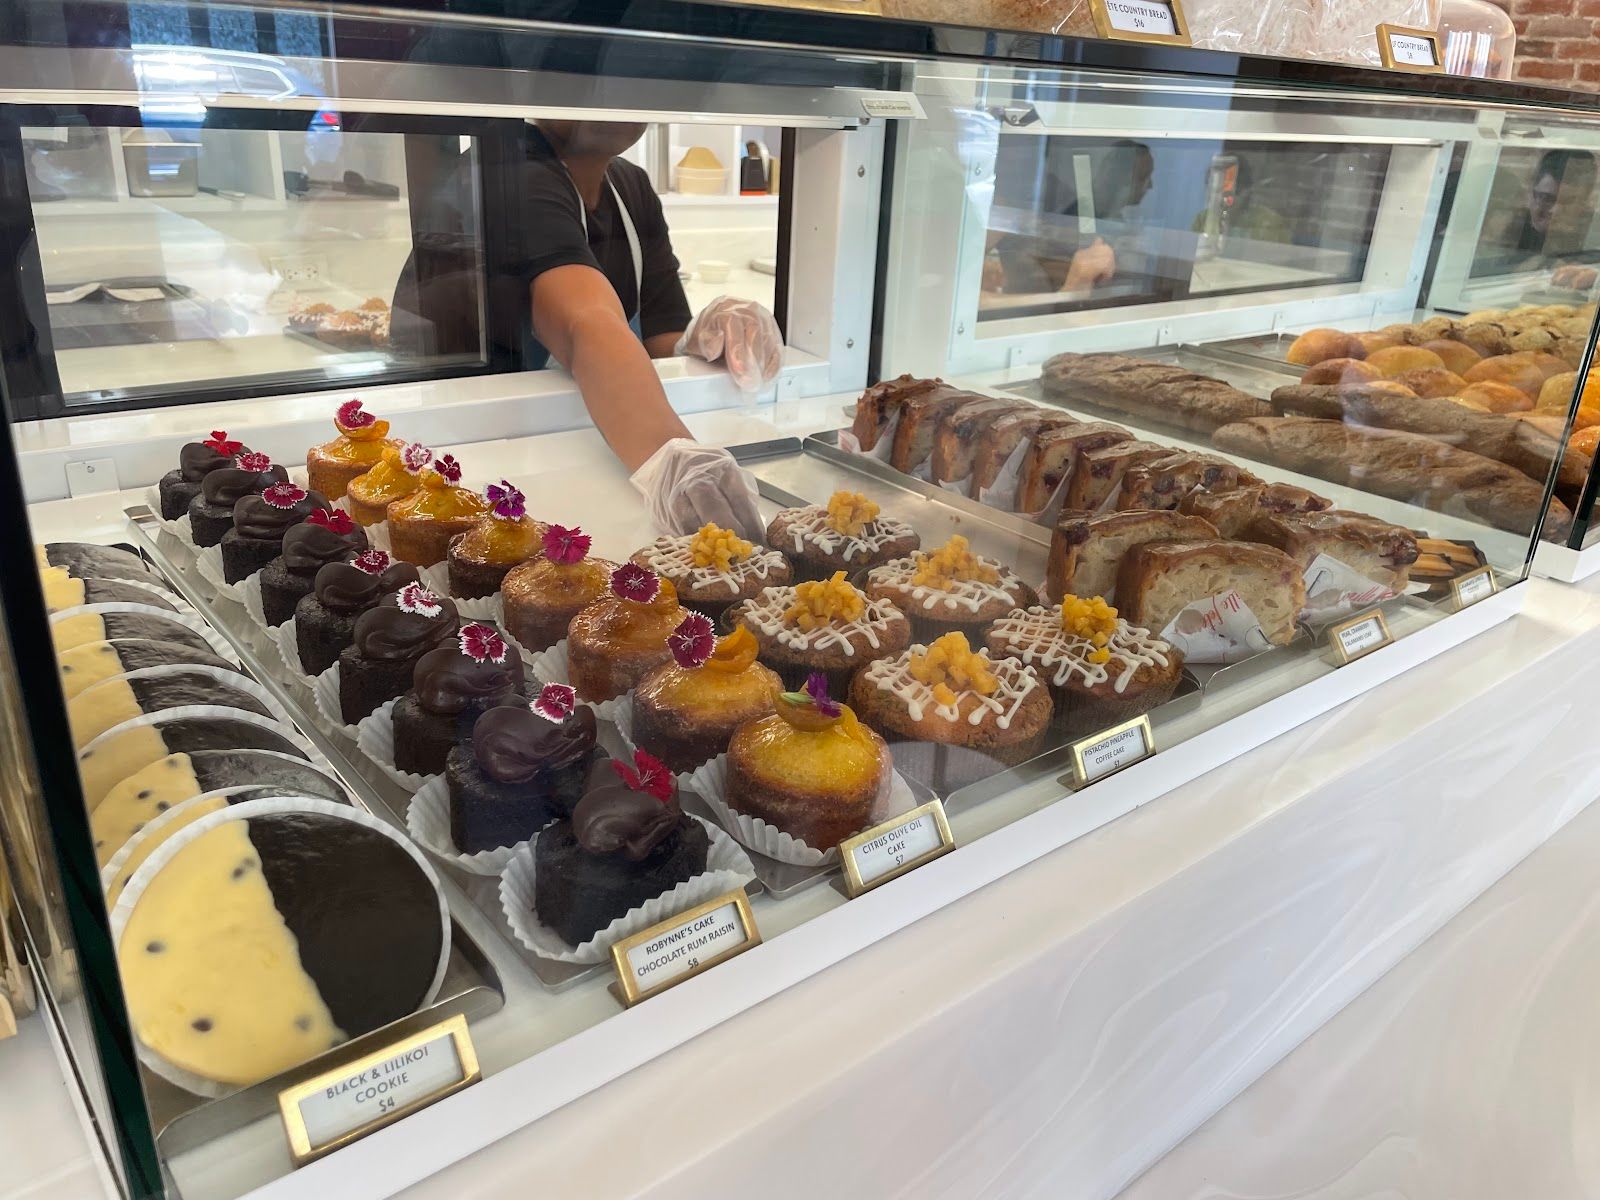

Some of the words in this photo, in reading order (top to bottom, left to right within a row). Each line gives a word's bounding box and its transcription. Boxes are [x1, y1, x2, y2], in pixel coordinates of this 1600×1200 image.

[1119, 4, 1148, 17] COUNTRY
[1149, 9, 1168, 20] BREAD
[1134, 17, 1145, 28] $16
[1397, 41, 1416, 49] COUNTRY
[1084, 742, 1110, 757] PISTACHIO
[1109, 729, 1135, 746] PINEAPPLE
[1095, 751, 1113, 764] COFFEE
[1113, 745, 1125, 756] CAKE
[862, 836, 888, 854] CITRUS
[888, 826, 909, 841] OLIVE
[909, 819, 922, 831] OIL
[887, 840, 906, 856] CAKE
[895, 854, 904, 866] $7
[645, 927, 693, 956] ROBYNNE'S
[694, 915, 715, 932] CAKE
[637, 948, 687, 977] CHOCOLATE
[687, 936, 708, 952] RUM
[708, 922, 736, 940] RAISIN
[687, 957, 699, 970] $8
[326, 1073, 368, 1100] BLACK
[371, 1068, 381, 1079] &
[384, 1046, 429, 1074] LILIKOI
[355, 1071, 409, 1104] COOKIE
[378, 1096, 395, 1113] $4
